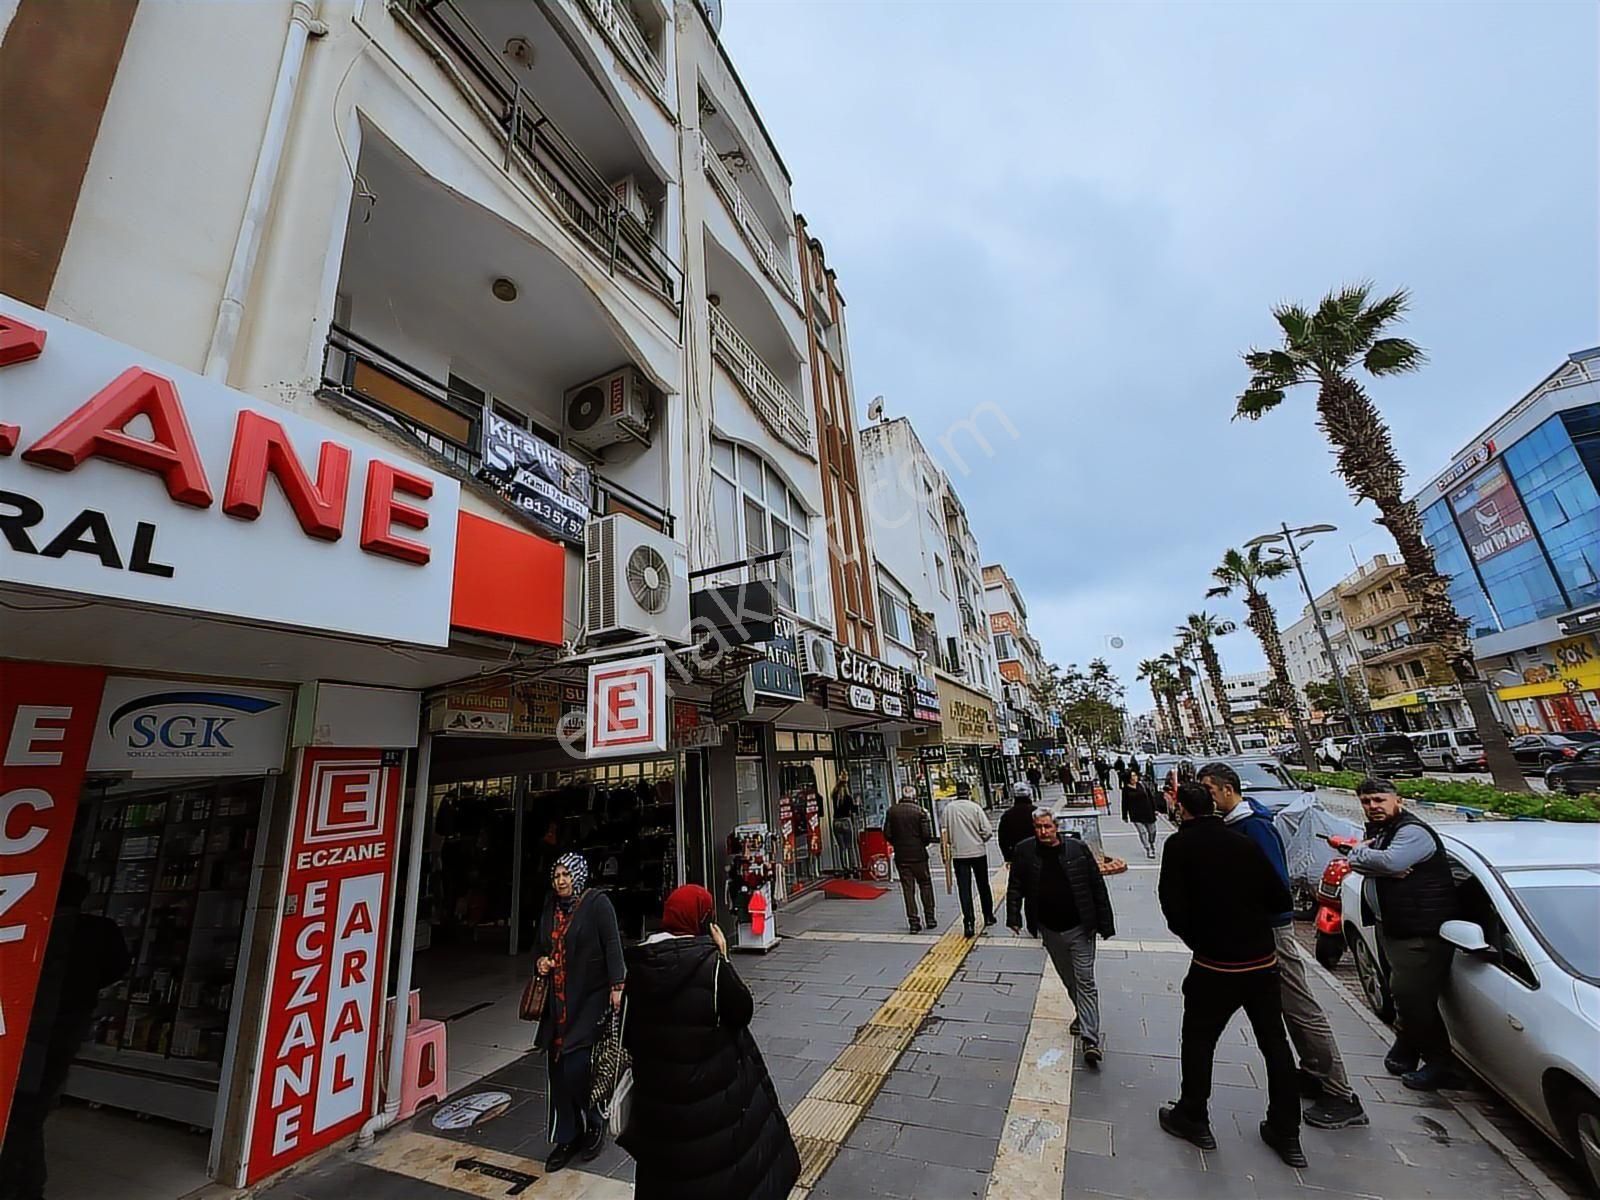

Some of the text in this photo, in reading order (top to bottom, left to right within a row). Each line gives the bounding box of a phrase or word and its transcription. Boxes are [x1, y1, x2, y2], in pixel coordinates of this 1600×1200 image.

[0, 312, 434, 568] ANE
[129, 715, 236, 749] SGK
[608, 682, 638, 732] E
[297, 842, 386, 870] ECZANE
[271, 880, 329, 1158] ECZANE
[331, 901, 374, 1096] ARAL
